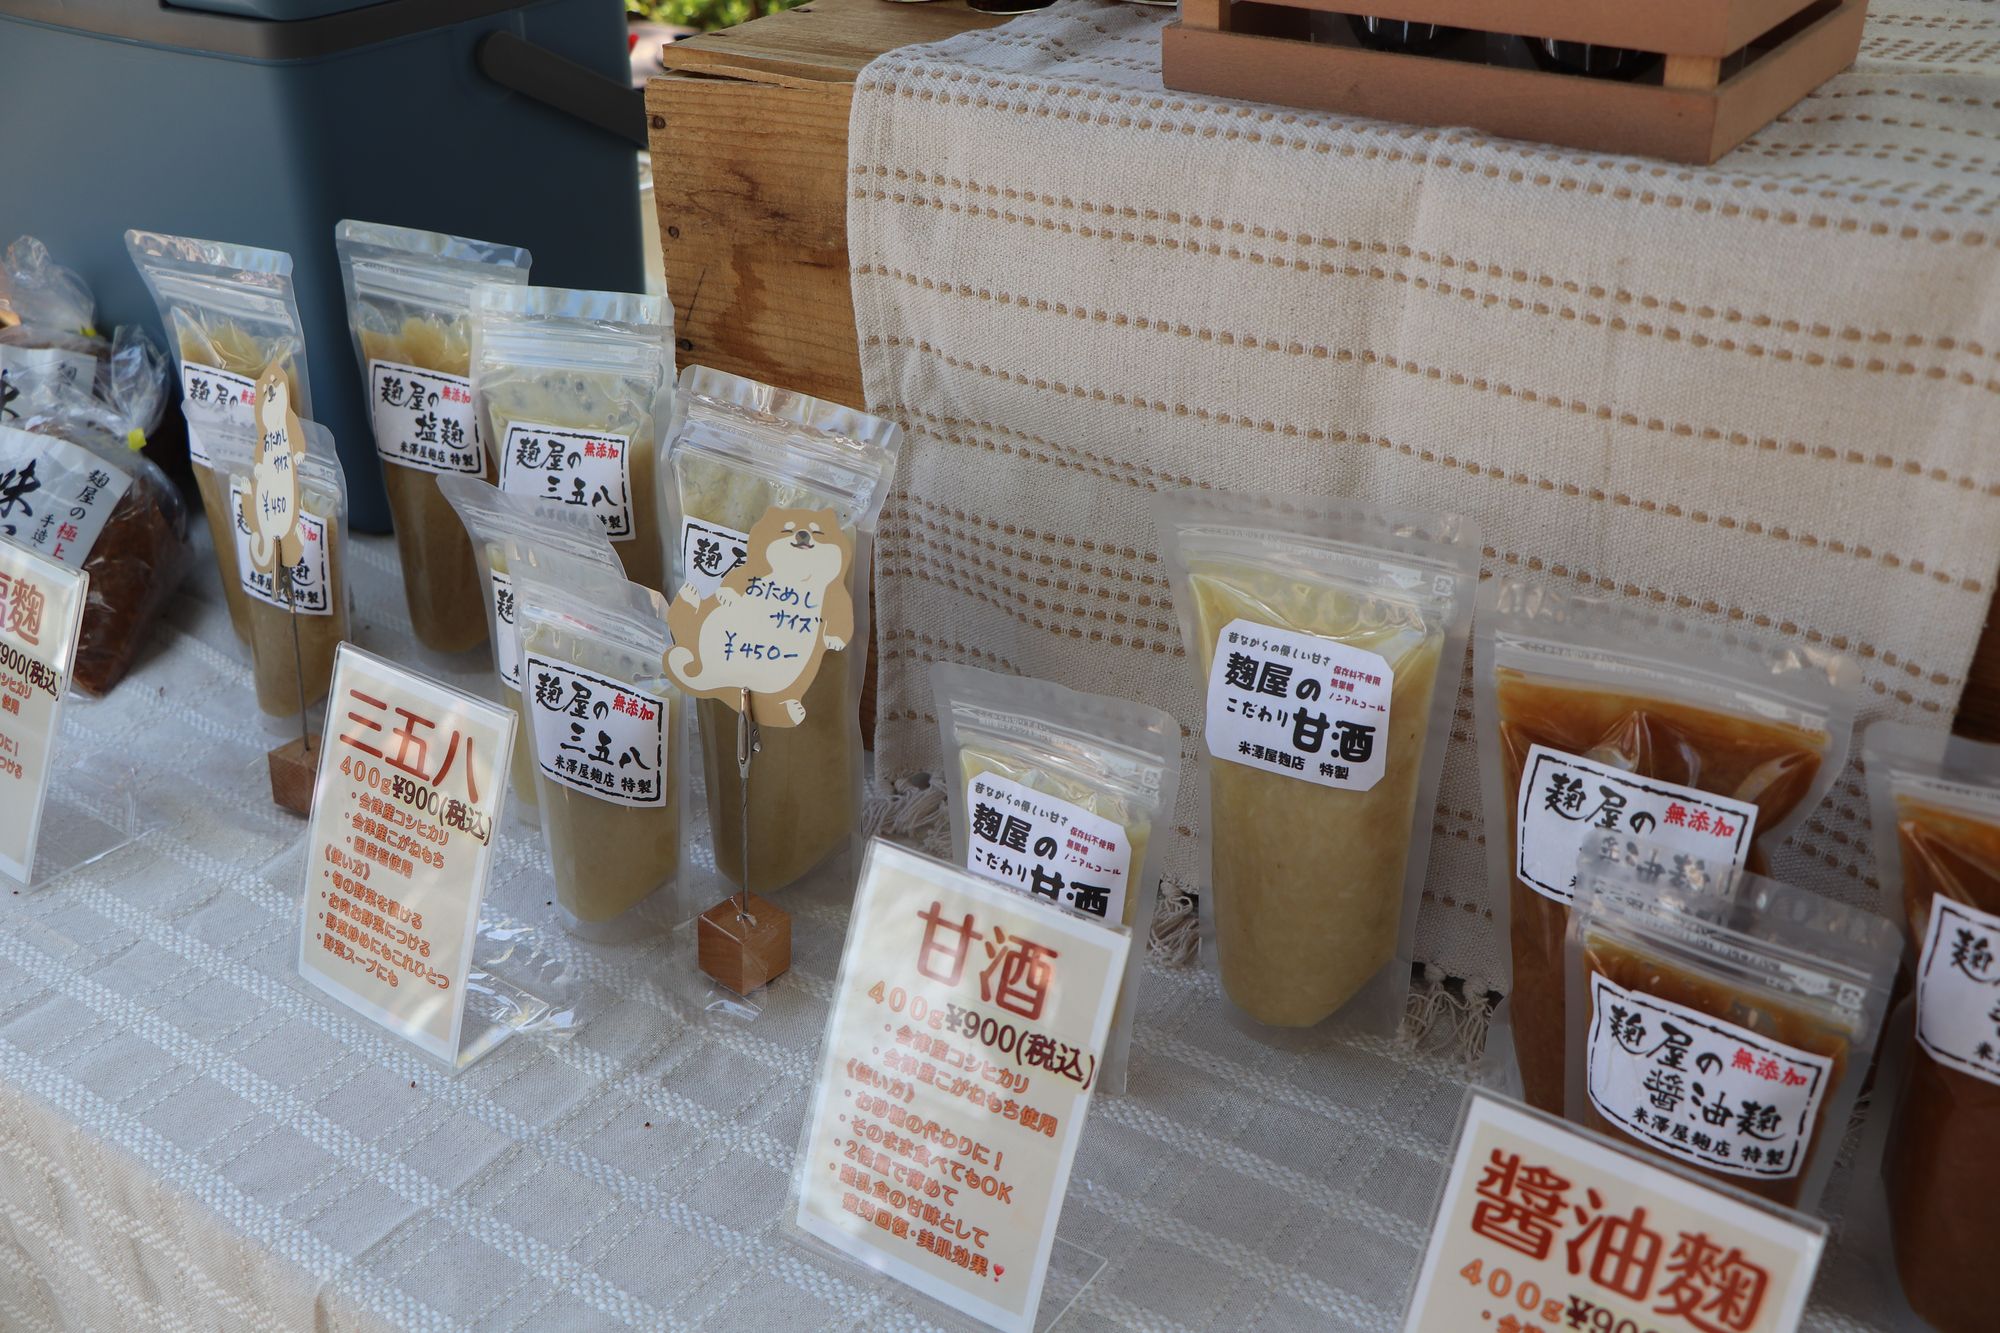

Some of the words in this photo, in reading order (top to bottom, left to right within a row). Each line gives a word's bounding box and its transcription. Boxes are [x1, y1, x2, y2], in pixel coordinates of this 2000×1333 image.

[380, 375, 440, 413] 麹屋の
[441, 385, 472, 404] 無添加
[263, 428, 288, 453] おためし
[274, 452, 291, 473] サイズ
[450, 453, 475, 468] 特製
[516, 436, 583, 473] 麹屋の
[583, 440, 620, 460] 無添加
[262, 490, 287, 521] ¥450
[539, 475, 619, 508] 三五八
[295, 589, 320, 605] 特製
[744, 576, 819, 610] おためし
[769, 611, 824, 633] サイズ
[1228, 631, 1331, 667] 昔ながらの優しい甘さ
[0, 671, 33, 700] シヒカリ
[534, 672, 609, 720] 麹屋の
[612, 693, 656, 722] 無添加
[1224, 651, 1322, 703] 麹屋の
[1333, 665, 1382, 687] 保存料不使用
[1329, 692, 1387, 713] ノンアルコール
[339, 688, 480, 805] 三五八
[559, 722, 652, 771] 三五八
[1225, 696, 1288, 729] こだわり
[1291, 707, 1377, 763] 甘酒
[339, 755, 392, 795] 400g
[1238, 740, 1306, 771] 米澤屋麹店
[1319, 762, 1350, 780] 特製
[620, 777, 653, 795] 特製
[974, 781, 1068, 827] 昔ながらの優しい甘さ
[1544, 772, 1657, 836] 麹屋の
[1663, 802, 1736, 838] 無添加
[351, 812, 447, 870] 会津産こがねもち
[358, 792, 450, 847] 会津産コシヒカリ
[973, 802, 1059, 861] 麹屋の
[1070, 826, 1117, 853] 保存料不使用
[975, 846, 1027, 882] こだわり
[1064, 853, 1122, 876] ノンアルコール
[324, 911, 451, 990] 野菜炒めにもこれひとつ
[916, 900, 1059, 1022] 甘酒
[895, 1023, 1031, 1095] 会津産コシヒカリ
[1607, 1003, 1724, 1076] 麹屋の
[1730, 1047, 1808, 1088] 無添加
[882, 1048, 1059, 1138] 会津産こがねもち使用
[1632, 1105, 1732, 1159] 米澤屋麹店
[1740, 1145, 1786, 1167] 特製
[842, 1139, 959, 1208] 2倍量で薄めて
[850, 1114, 1015, 1206] そのまま食べてもOK
[838, 1162, 990, 1250] 離乳食の甘味として
